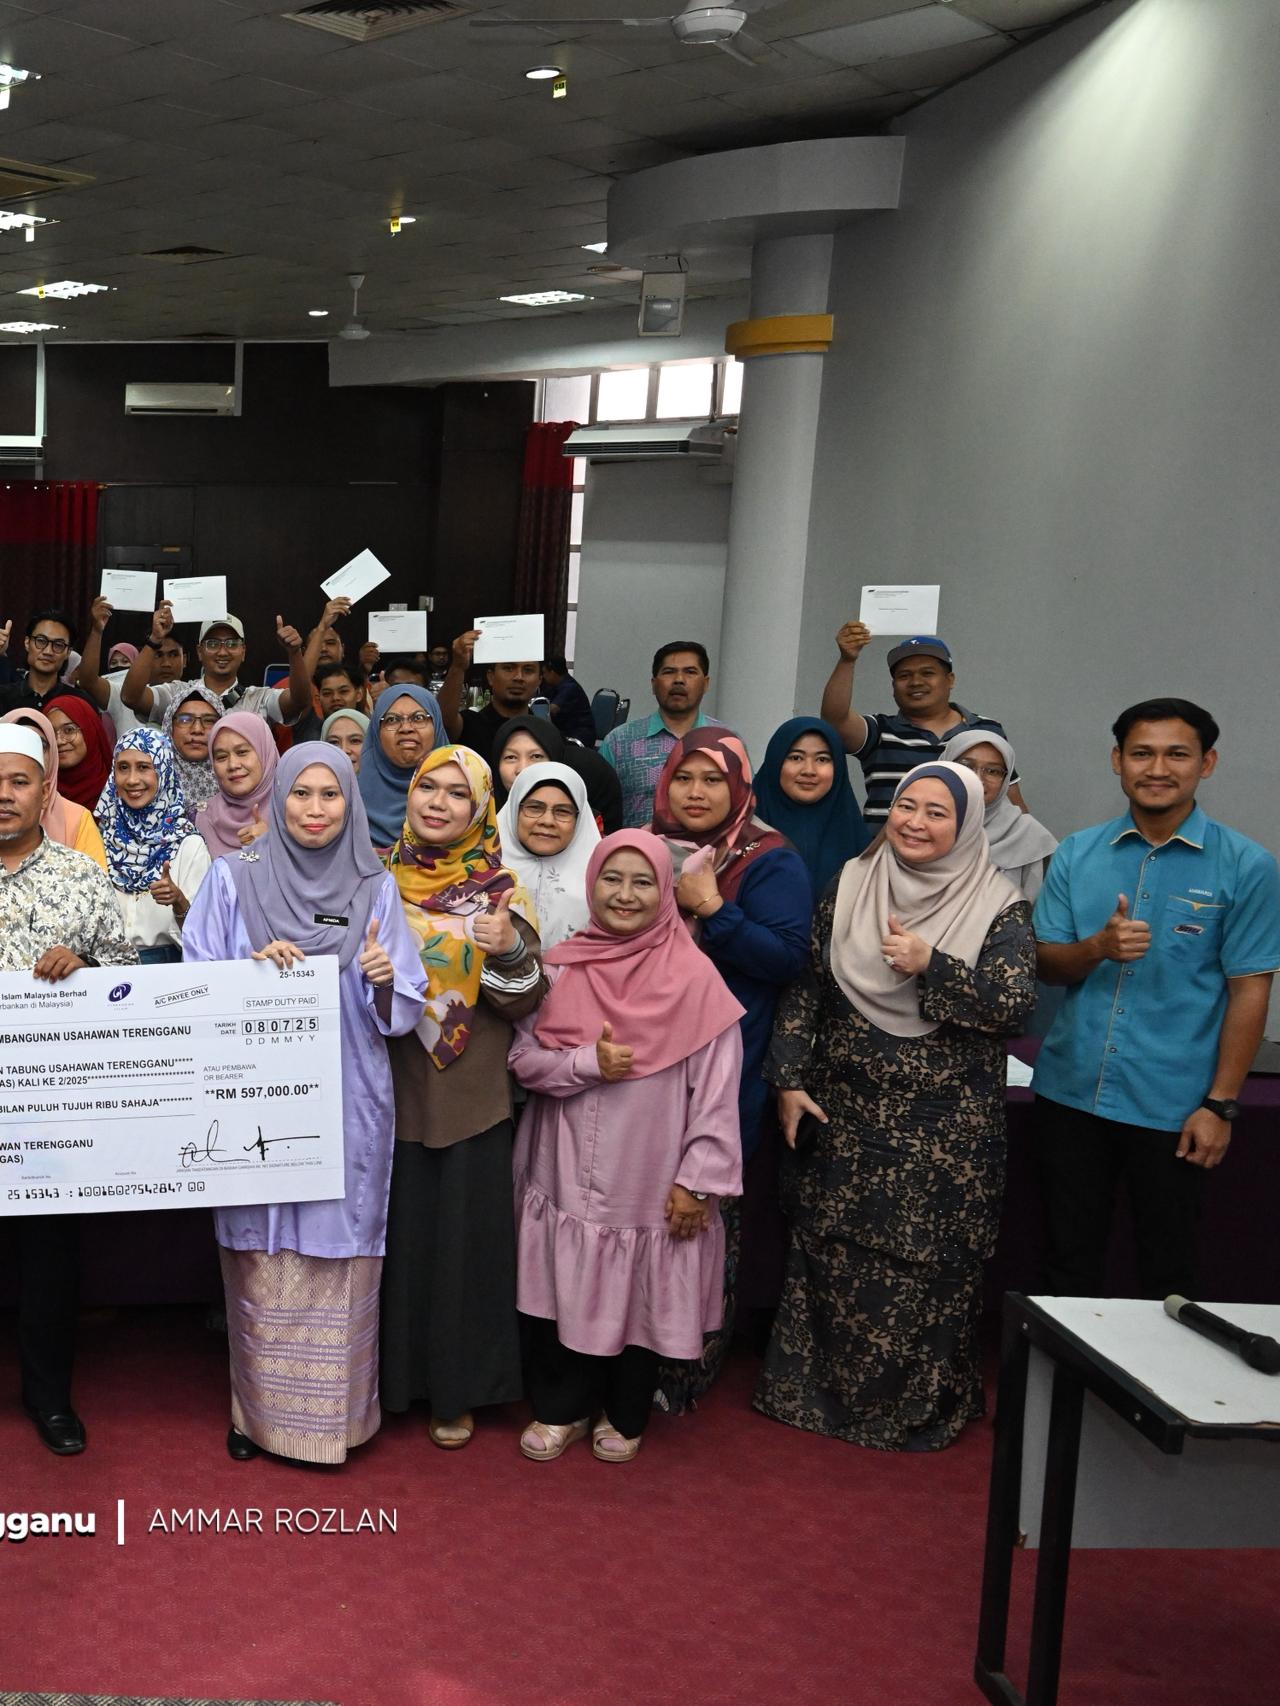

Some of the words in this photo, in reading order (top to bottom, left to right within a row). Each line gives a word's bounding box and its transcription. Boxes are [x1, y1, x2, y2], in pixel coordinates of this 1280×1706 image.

[278, 969, 315, 979] 25-15343
[0, 992, 23, 1001] Islam
[23, 991, 58, 1001] Malaysia
[58, 989, 87, 998] Berhad
[153, 997, 167, 1006] A/C
[166, 991, 190, 1003] PAYEE
[190, 986, 210, 997] ONLY
[29, 1001, 37, 1009] di
[37, 1000, 74, 1009] Malaysia)
[245, 998, 274, 1008] STAMP
[273, 997, 297, 1007] DUTY
[297, 996, 317, 1005] PAID
[62, 1028, 120, 1041] USAHAWAN
[121, 1025, 191, 1038] TERENGGANU
[5, 1064, 46, 1075] TABUNG
[48, 1061, 104, 1073] USAHAWAN
[221, 1063, 257, 1072] PEMBAWA
[17, 1077, 40, 1087] KALI
[42, 1076, 56, 1086] KE
[203, 1073, 215, 1081] OR
[214, 1072, 244, 1081] BEARER
[27, 1102, 60, 1112] PULUH
[61, 1101, 93, 1111] TUJUH
[95, 1099, 119, 1109] RIBU
[23, 1138, 93, 1150] TERENGGANU
[7, 1189, 21, 1200] 25
[25, 1187, 60, 1200] 15343
[187, 1180, 206, 1193] 00
